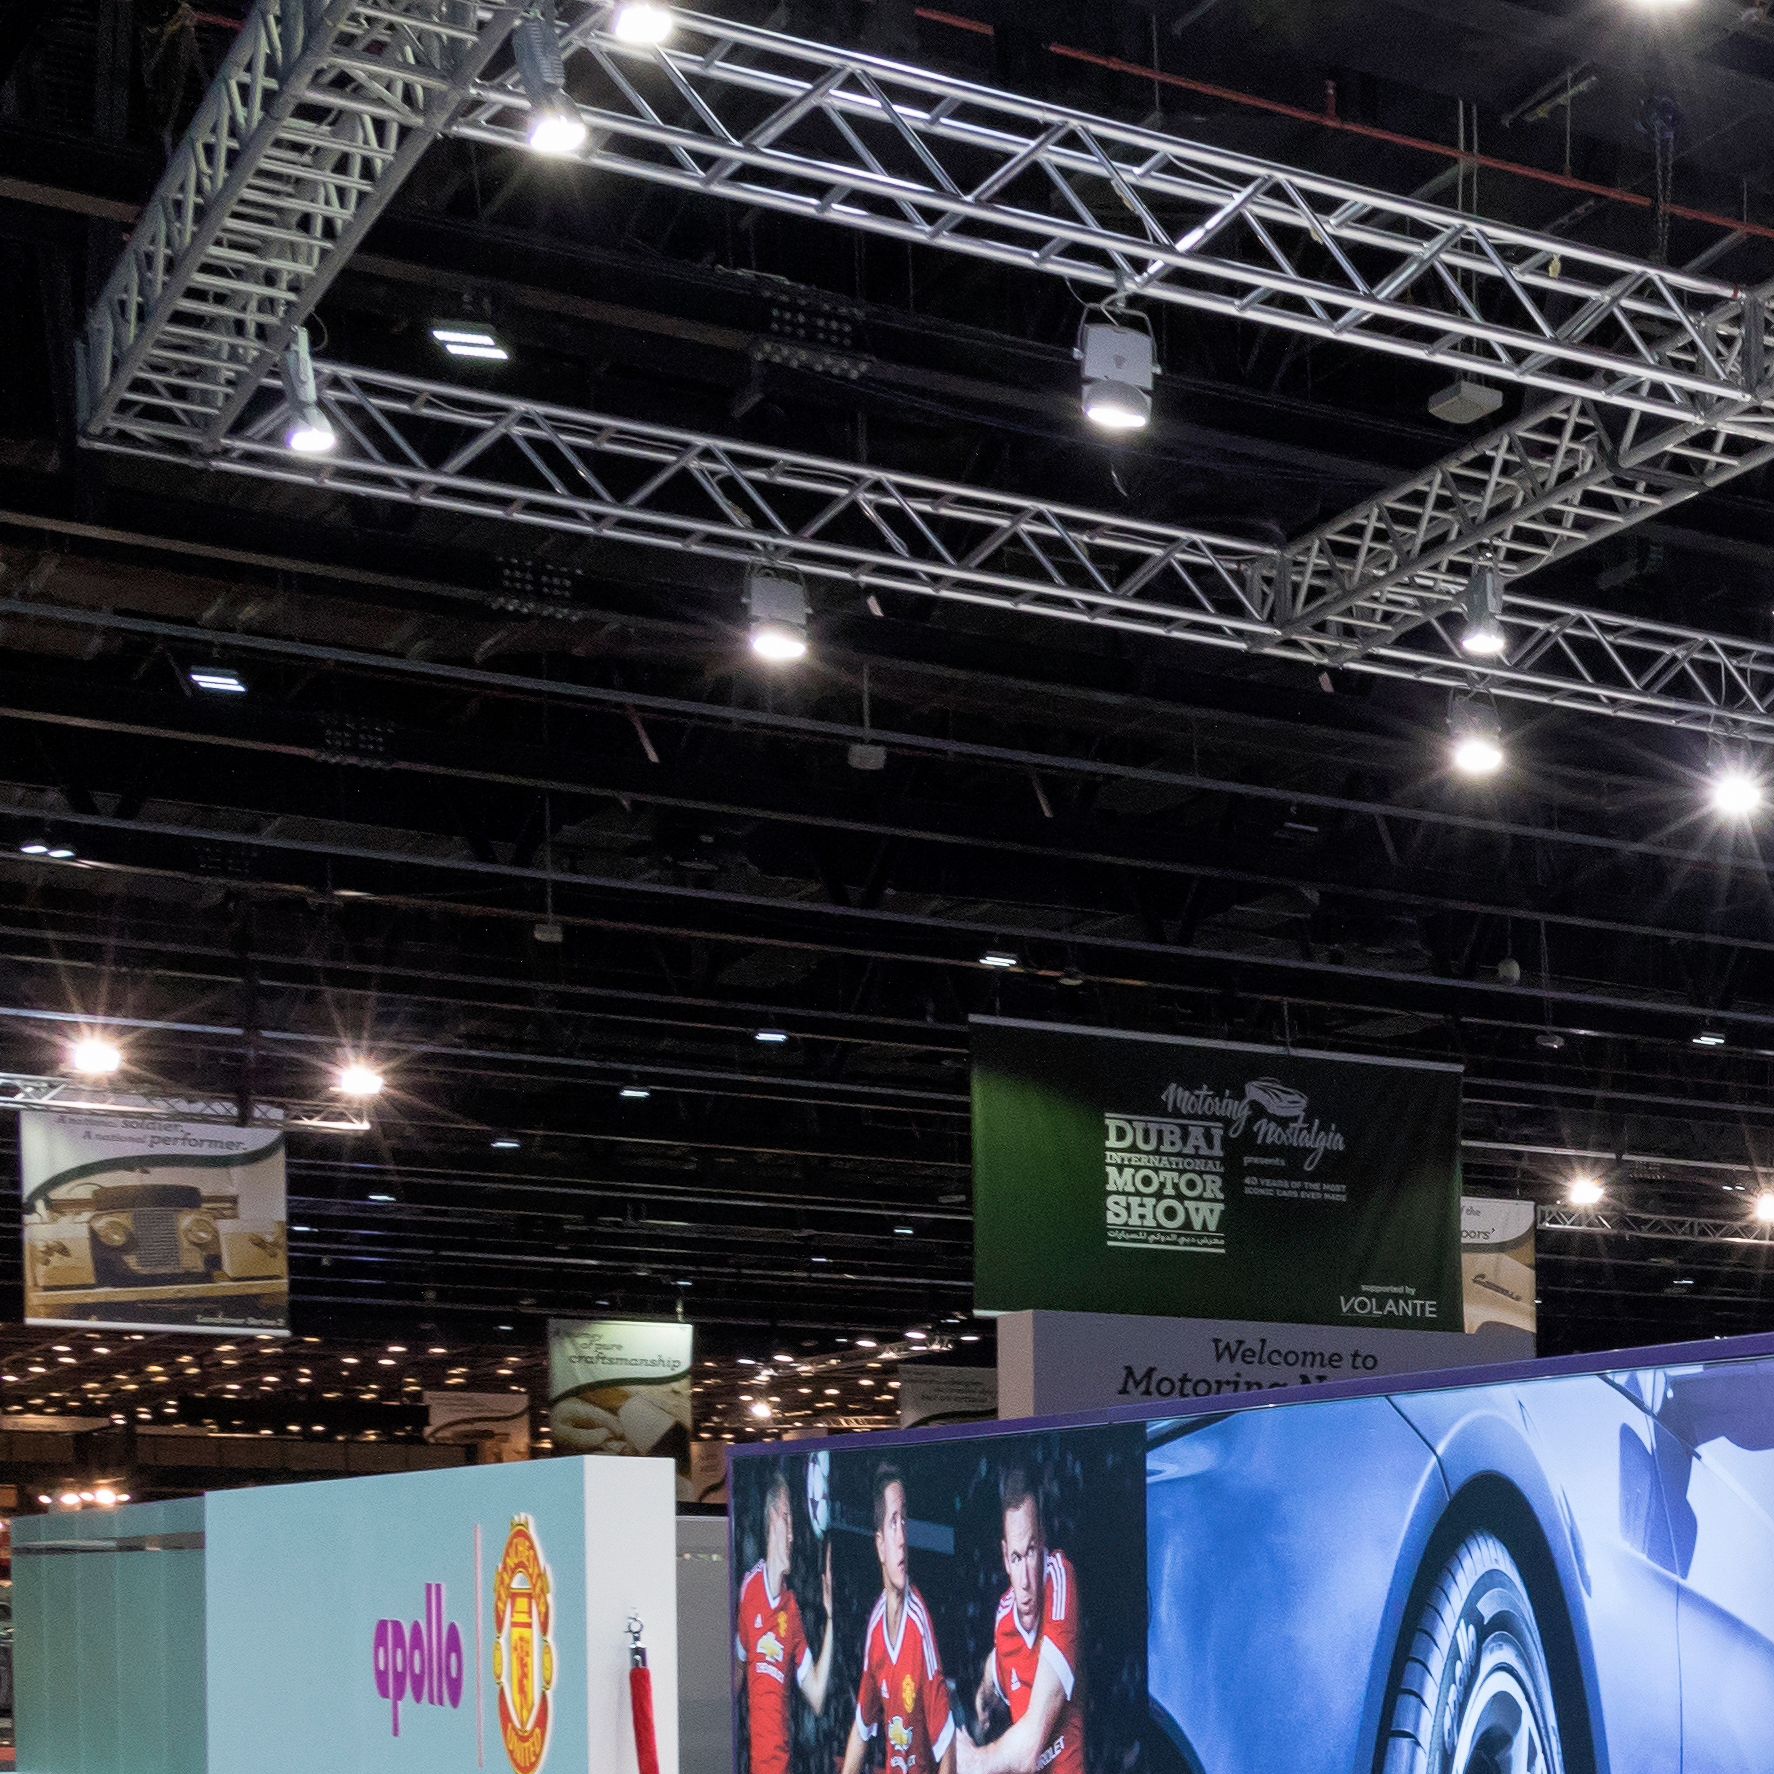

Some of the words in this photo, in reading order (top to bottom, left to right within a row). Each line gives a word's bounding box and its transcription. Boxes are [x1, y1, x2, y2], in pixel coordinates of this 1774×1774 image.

[1161, 1082, 1252, 1138] Motoring
[1105, 1118, 1224, 1157] DUBAI
[1253, 1113, 1345, 1171] Nostalgia
[1105, 1151, 1224, 1172] INTERNATIONAL
[1105, 1166, 1224, 1200] MOTOR
[1106, 1194, 1225, 1232] SHOW
[1340, 1296, 1438, 1318] VOLANTE
[568, 1353, 682, 1372] craftsmanship
[1211, 1337, 1342, 1368] Welcome
[1350, 1349, 1378, 1371] to
[374, 1583, 464, 1737] apollo
[1443, 1617, 1477, 1755] apollo
